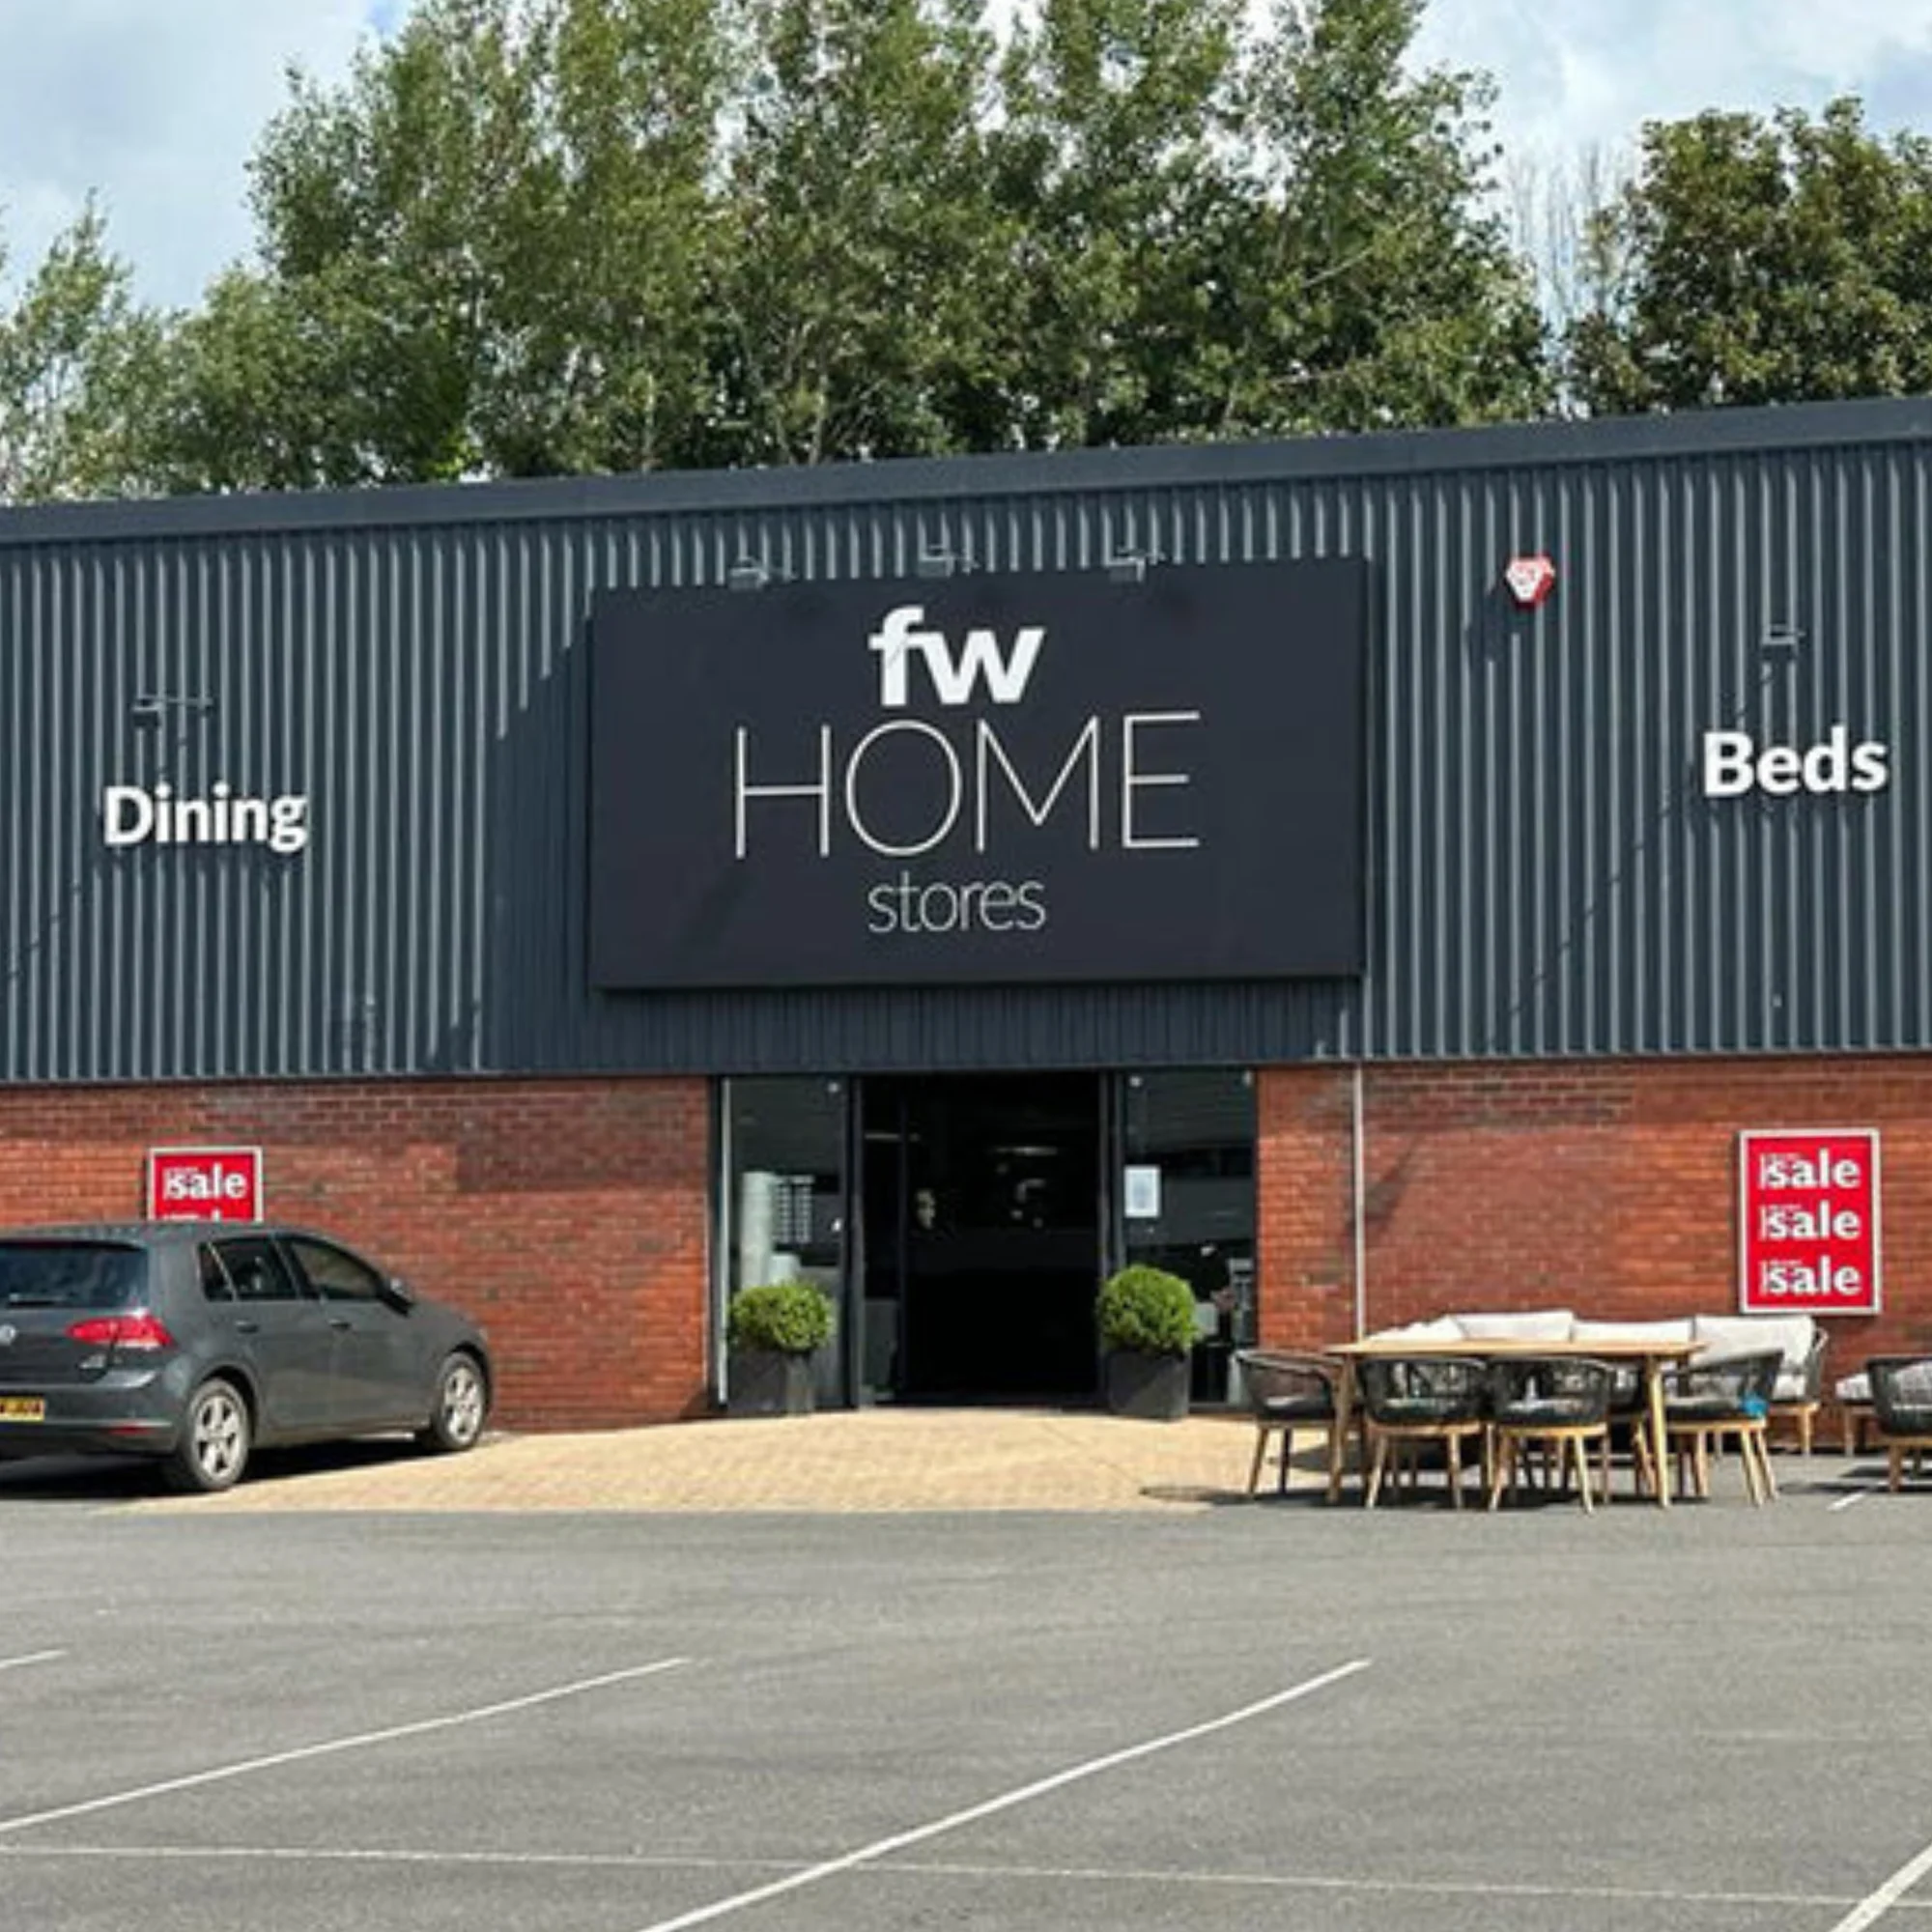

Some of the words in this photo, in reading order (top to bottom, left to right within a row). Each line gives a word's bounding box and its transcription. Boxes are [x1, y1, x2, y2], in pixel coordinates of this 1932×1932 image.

[868, 606, 1044, 706] fw
[735, 711, 1201, 859] HOME
[1704, 724, 1889, 797] Beds
[104, 781, 307, 853] Dining
[867, 870, 1045, 933] stores
